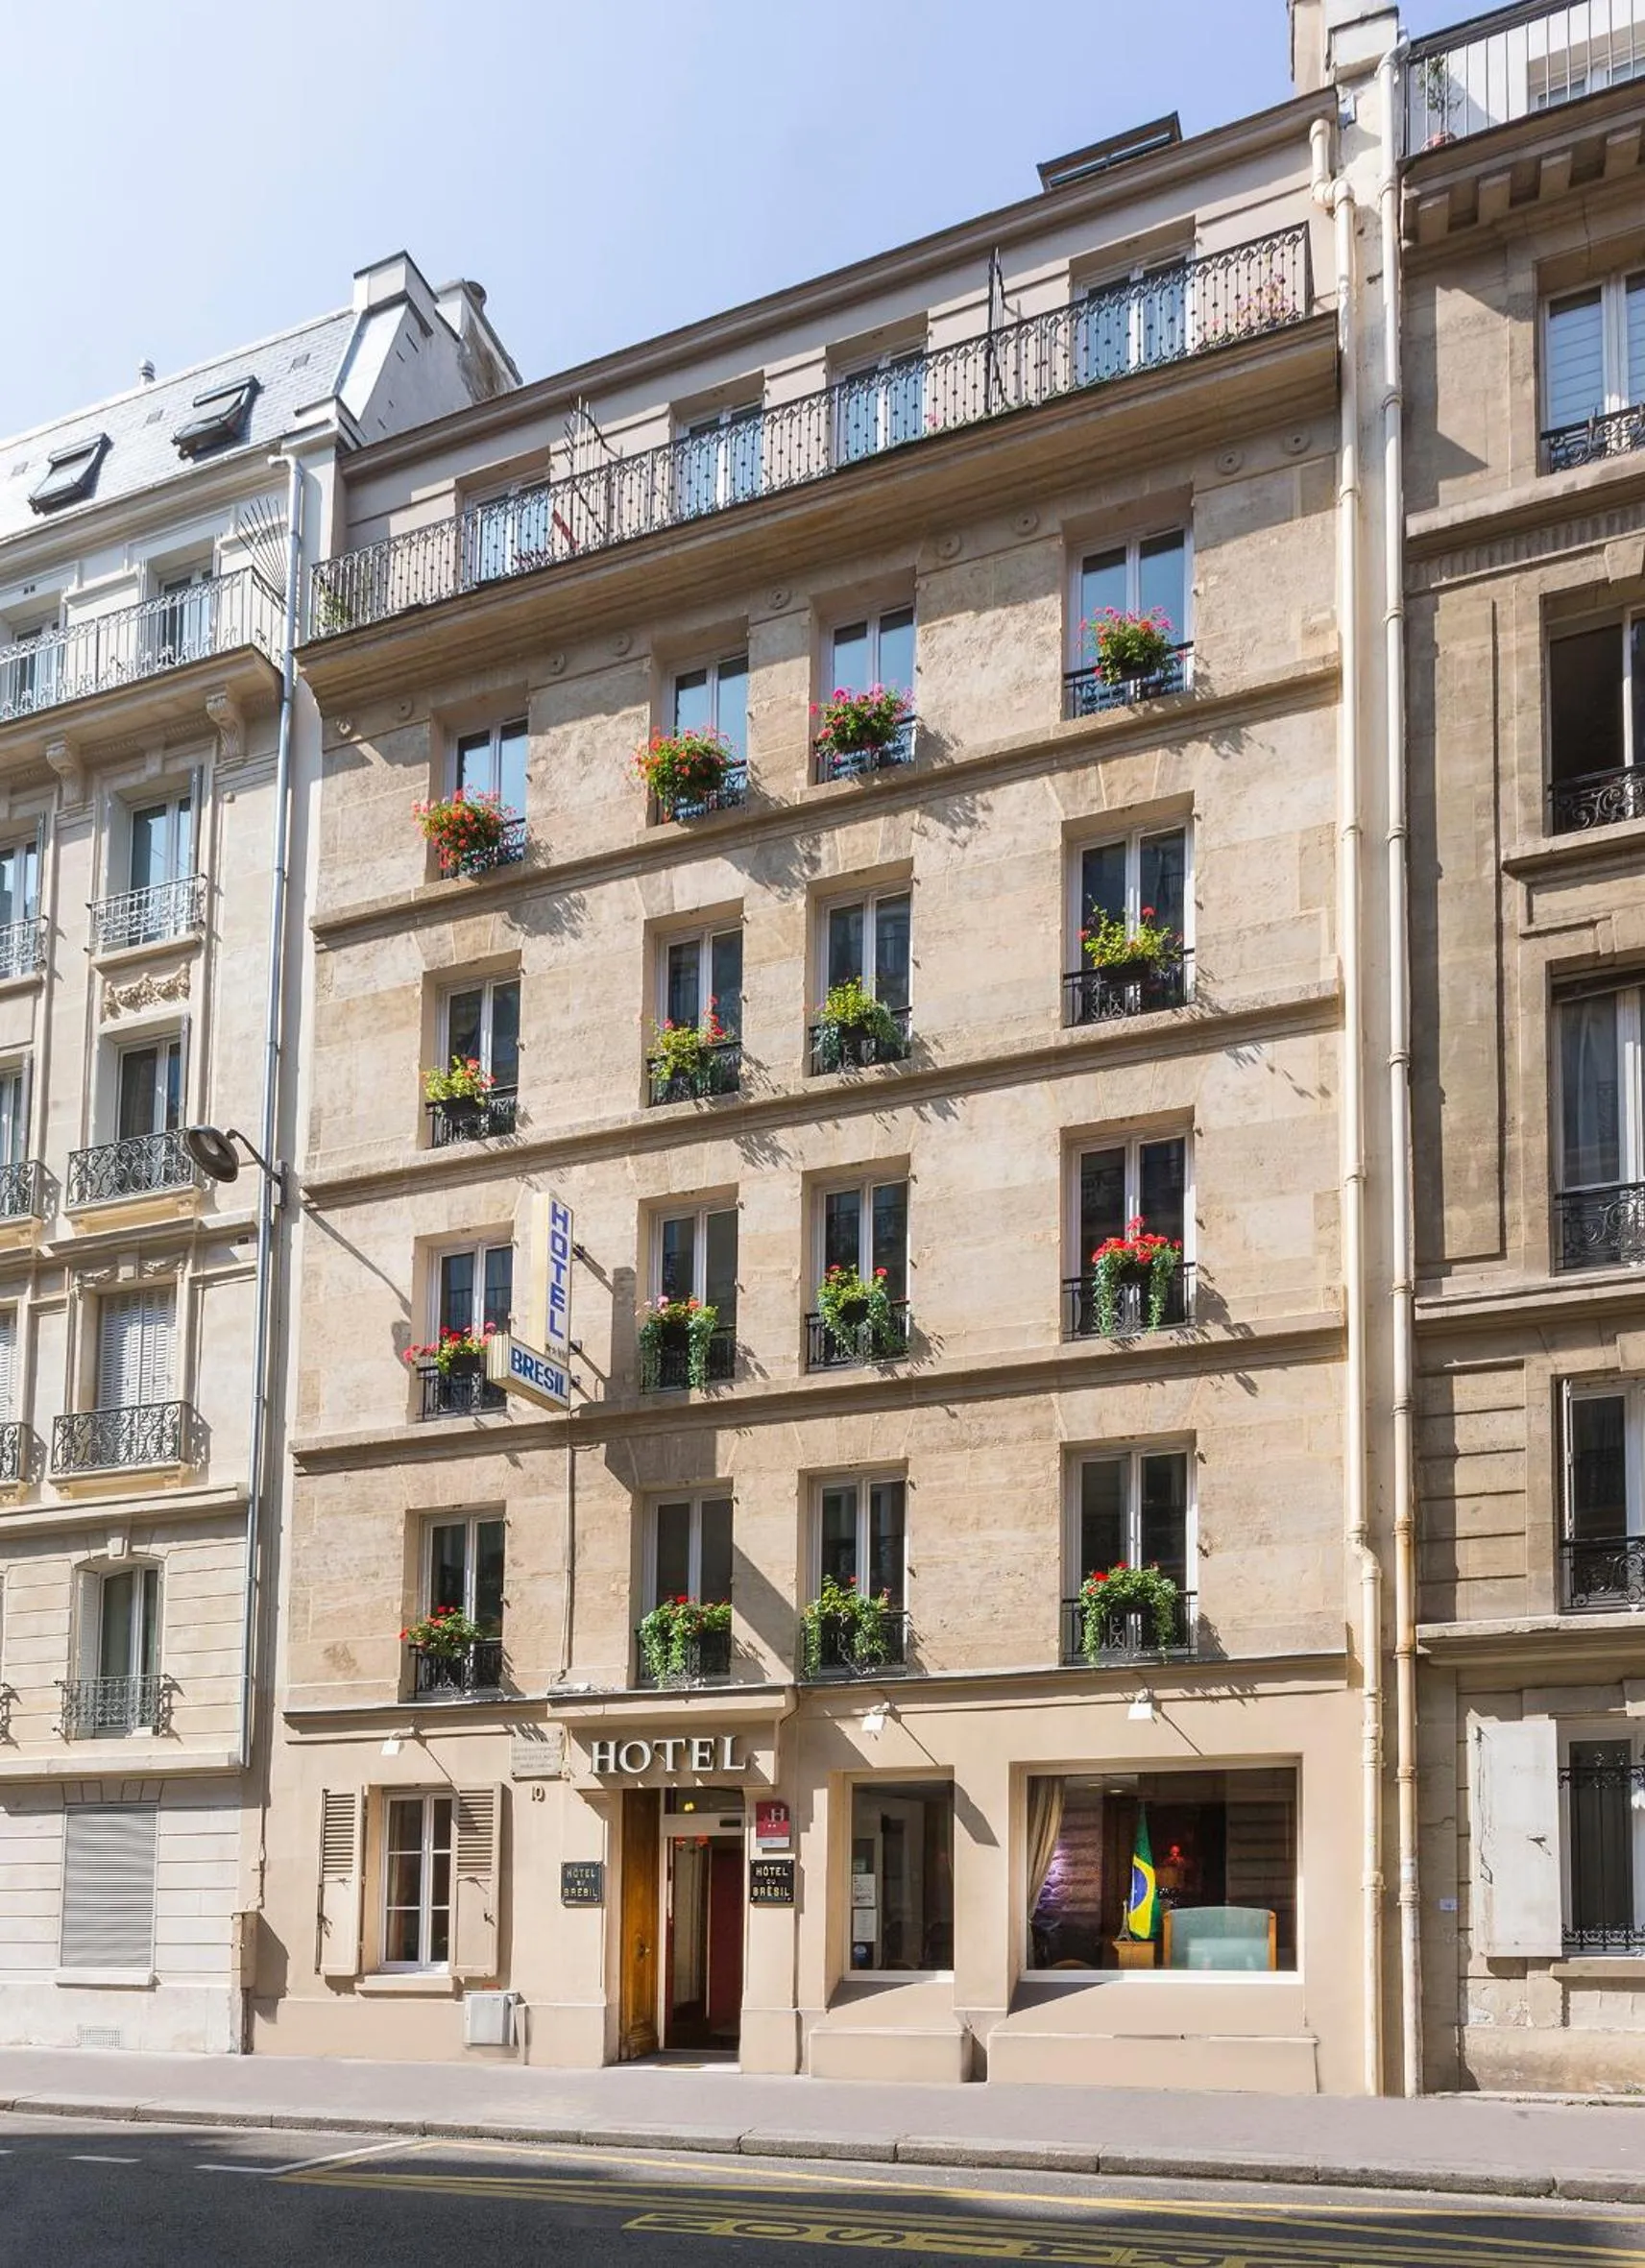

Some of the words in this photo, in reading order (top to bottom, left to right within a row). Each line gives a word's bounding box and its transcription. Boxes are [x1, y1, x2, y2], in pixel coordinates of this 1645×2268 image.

[548, 1200, 568, 1339] HOTEL
[511, 1346, 568, 1399] BRESIL
[590, 1735, 746, 1774] HOTEL
[771, 1808, 785, 1822] H
